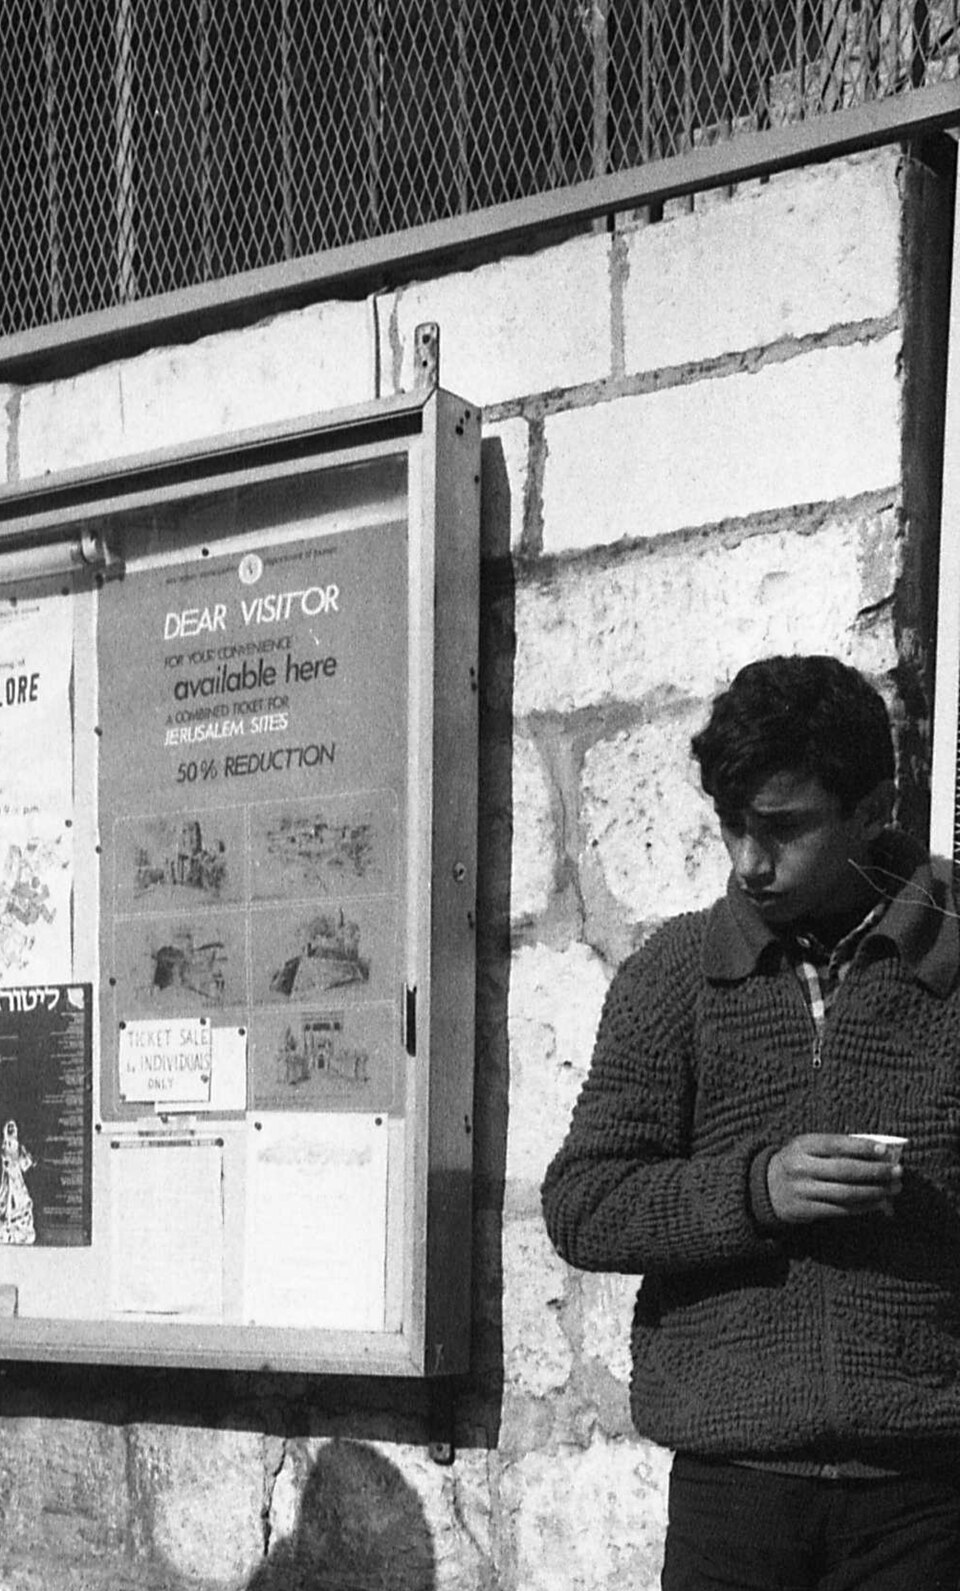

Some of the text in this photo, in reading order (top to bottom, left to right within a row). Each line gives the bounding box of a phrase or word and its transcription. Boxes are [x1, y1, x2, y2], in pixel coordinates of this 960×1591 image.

[164, 584, 339, 640] DEAR VISITOR
[164, 654, 184, 668] FOR
[189, 649, 215, 664] YOUR
[174, 653, 337, 701] available here
[175, 704, 229, 724] COMBINED
[233, 699, 262, 715] TICKET
[268, 695, 289, 710] FOR
[164, 712, 288, 746] JERUSALEM SITES
[176, 743, 335, 783] 50% REDUCTION
[127, 1028, 208, 1048] TICKET SALE
[140, 1053, 210, 1071] INDIVIDUALS
[147, 1077, 174, 1090] ONLY
